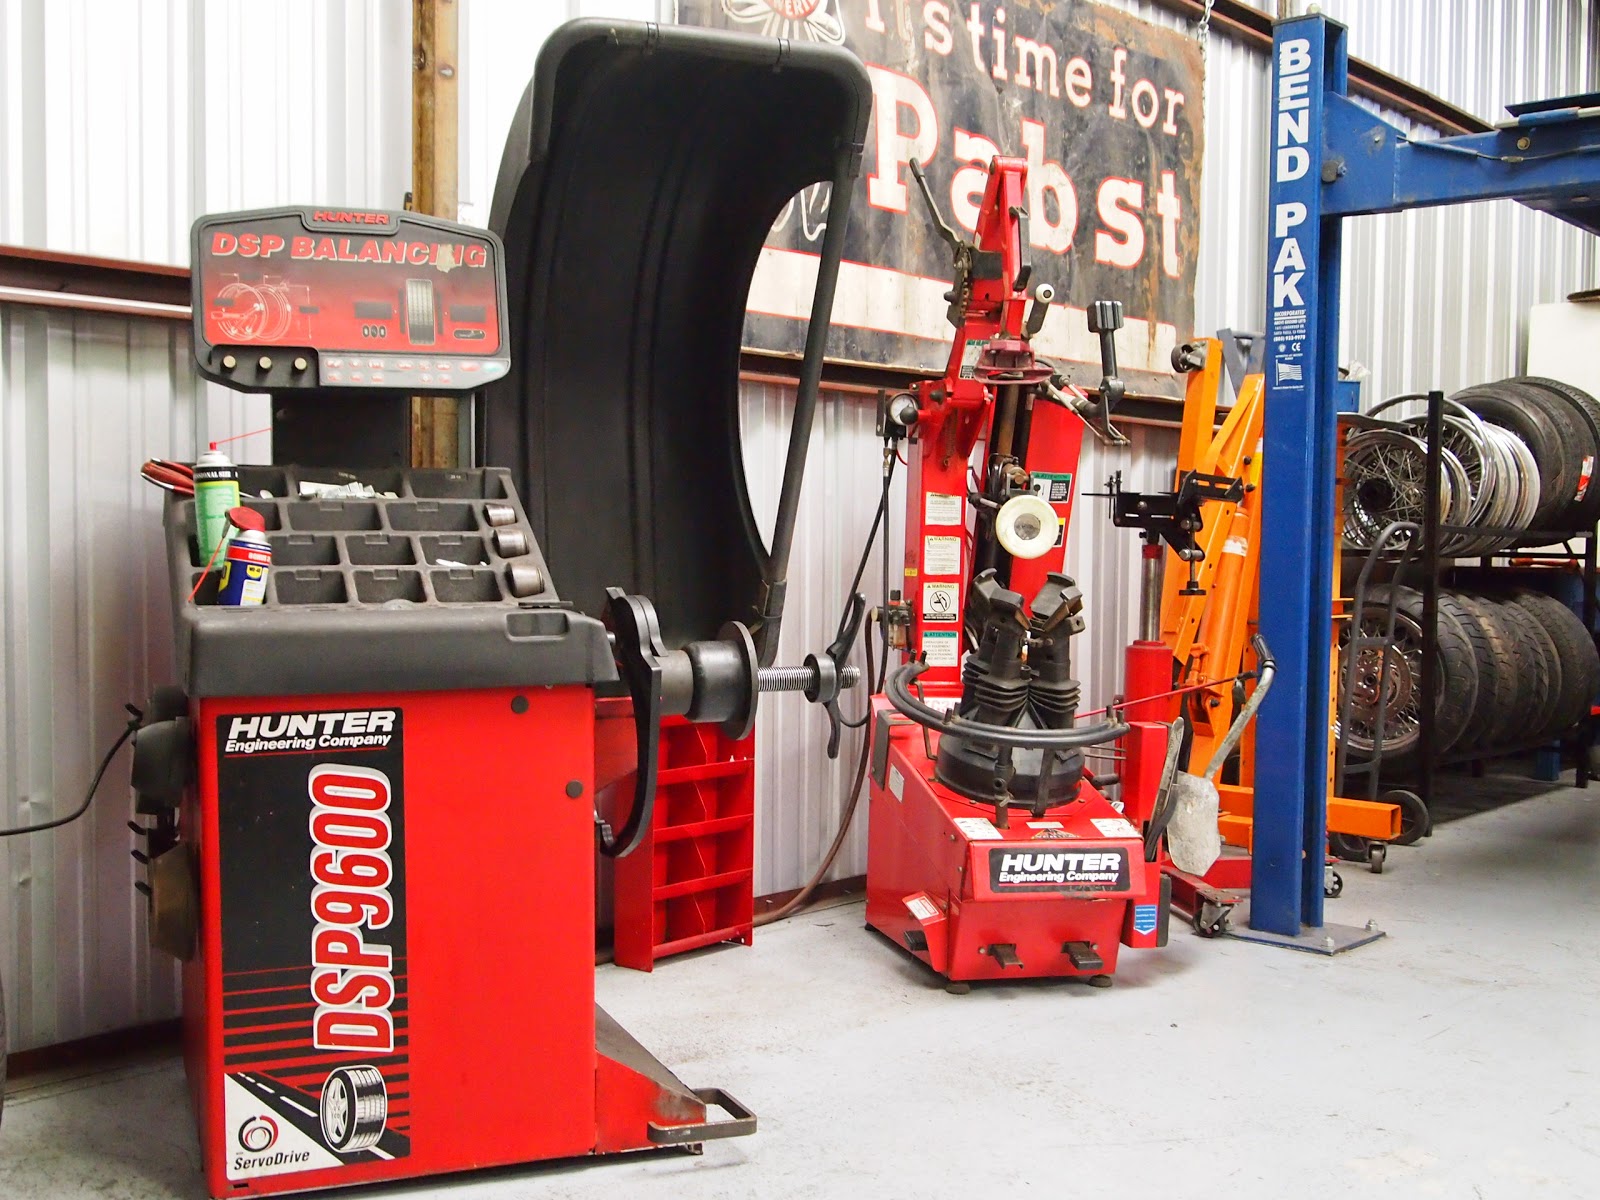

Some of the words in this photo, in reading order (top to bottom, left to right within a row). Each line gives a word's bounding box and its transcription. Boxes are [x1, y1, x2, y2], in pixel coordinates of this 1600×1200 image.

[965, 6, 1093, 107] time
[1108, 48, 1184, 136] for
[1277, 38, 1311, 183] BEND
[866, 63, 1182, 280] Pabst
[313, 210, 389, 225] HUNTER
[211, 232, 285, 258] DSP
[1273, 202, 1307, 309] PAK
[228, 710, 396, 739] HUNTER
[225, 736, 316, 753] Engineering
[319, 733, 392, 748] Company
[1001, 853, 1121, 871] HUNTER
[998, 871, 1065, 884] Engineering
[1066, 871, 1119, 883] Company
[308, 763, 395, 1052] DSP9600
[234, 1150, 310, 1171] ServoDrive
